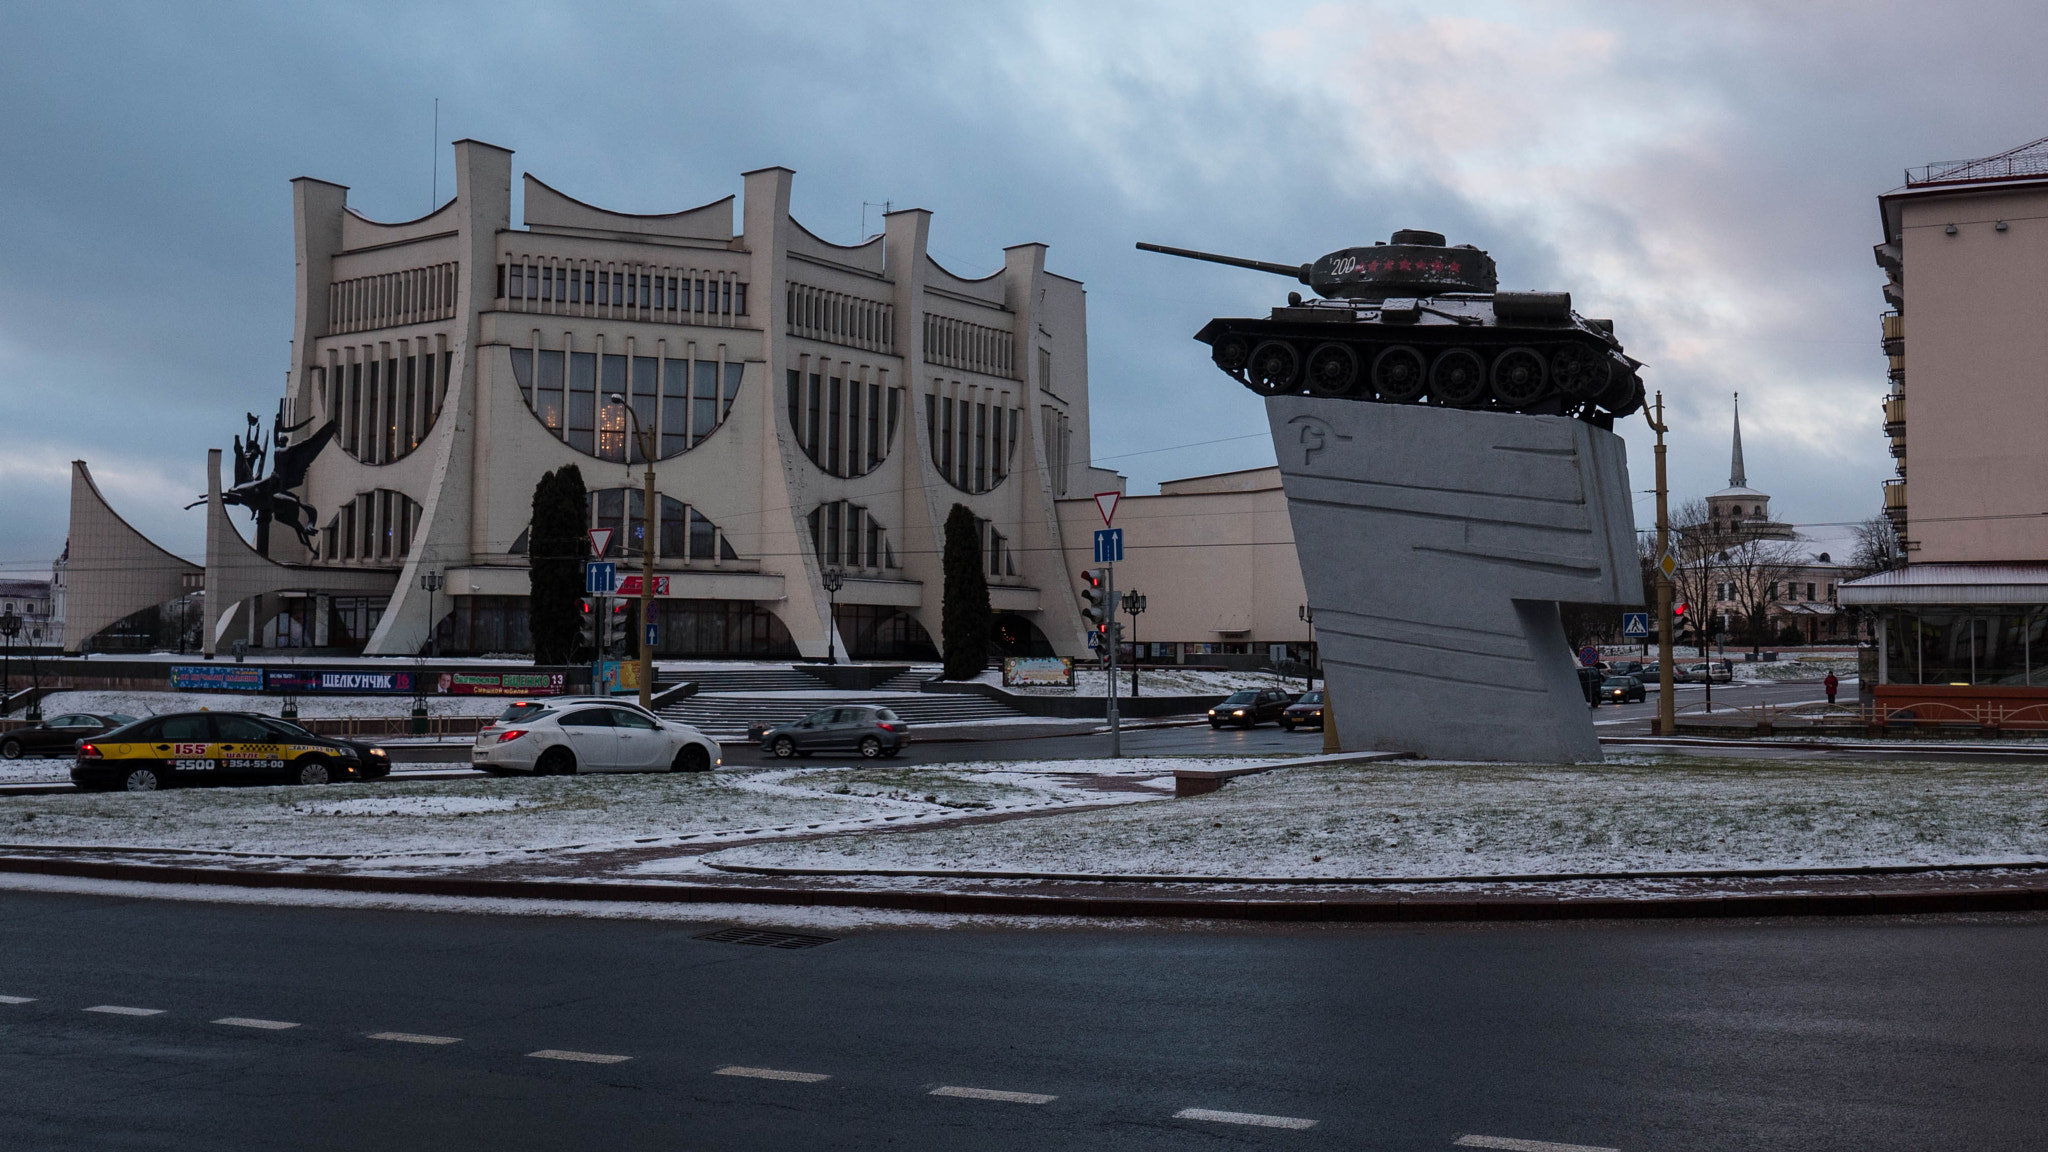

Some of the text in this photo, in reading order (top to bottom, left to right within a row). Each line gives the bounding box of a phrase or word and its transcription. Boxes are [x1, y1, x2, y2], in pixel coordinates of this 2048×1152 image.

[1331, 256, 1356, 276] 200
[322, 674, 391, 688] ЩЕЛКУНЧИК
[396, 674, 409, 686] 16
[502, 674, 551, 688] ЕЩЕНКО
[552, 674, 563, 684] 13
[176, 760, 215, 770] 5500
